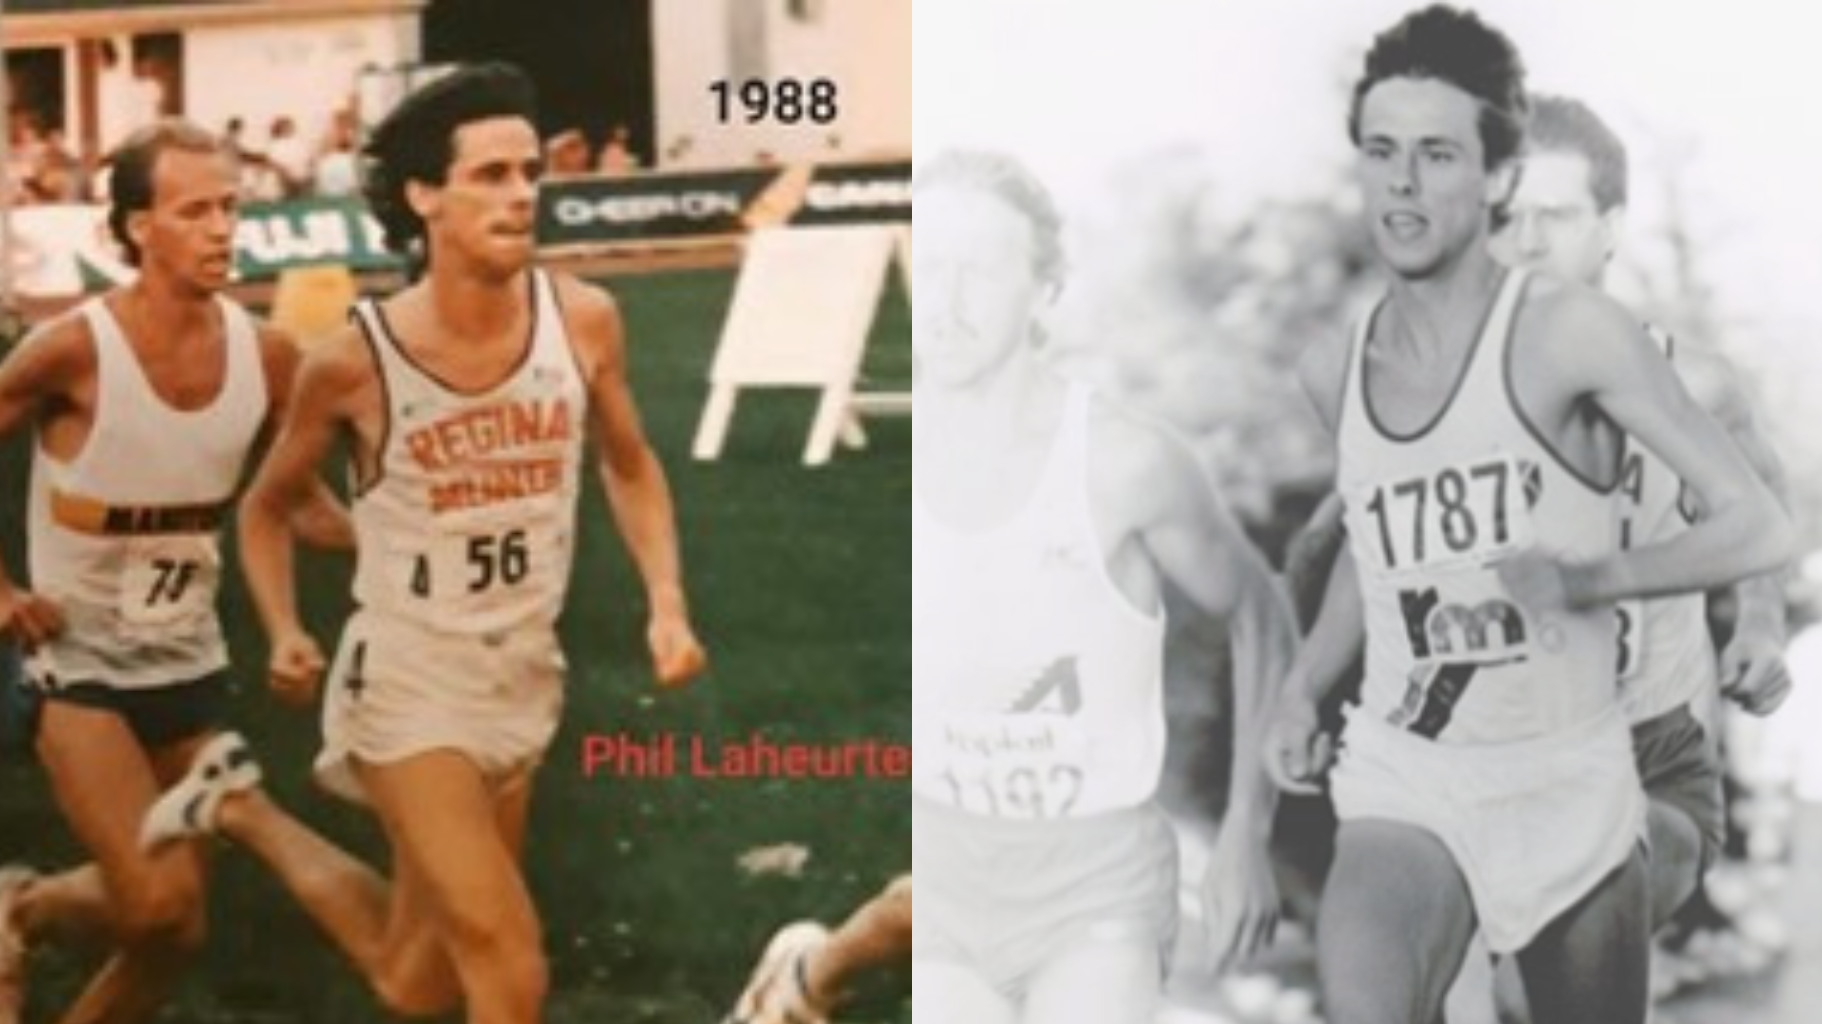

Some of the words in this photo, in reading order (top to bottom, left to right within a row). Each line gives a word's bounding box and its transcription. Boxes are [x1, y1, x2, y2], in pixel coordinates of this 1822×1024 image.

[404, 400, 571, 472] REGINA
[1366, 460, 1509, 569] 1787
[467, 530, 529, 592] 56
